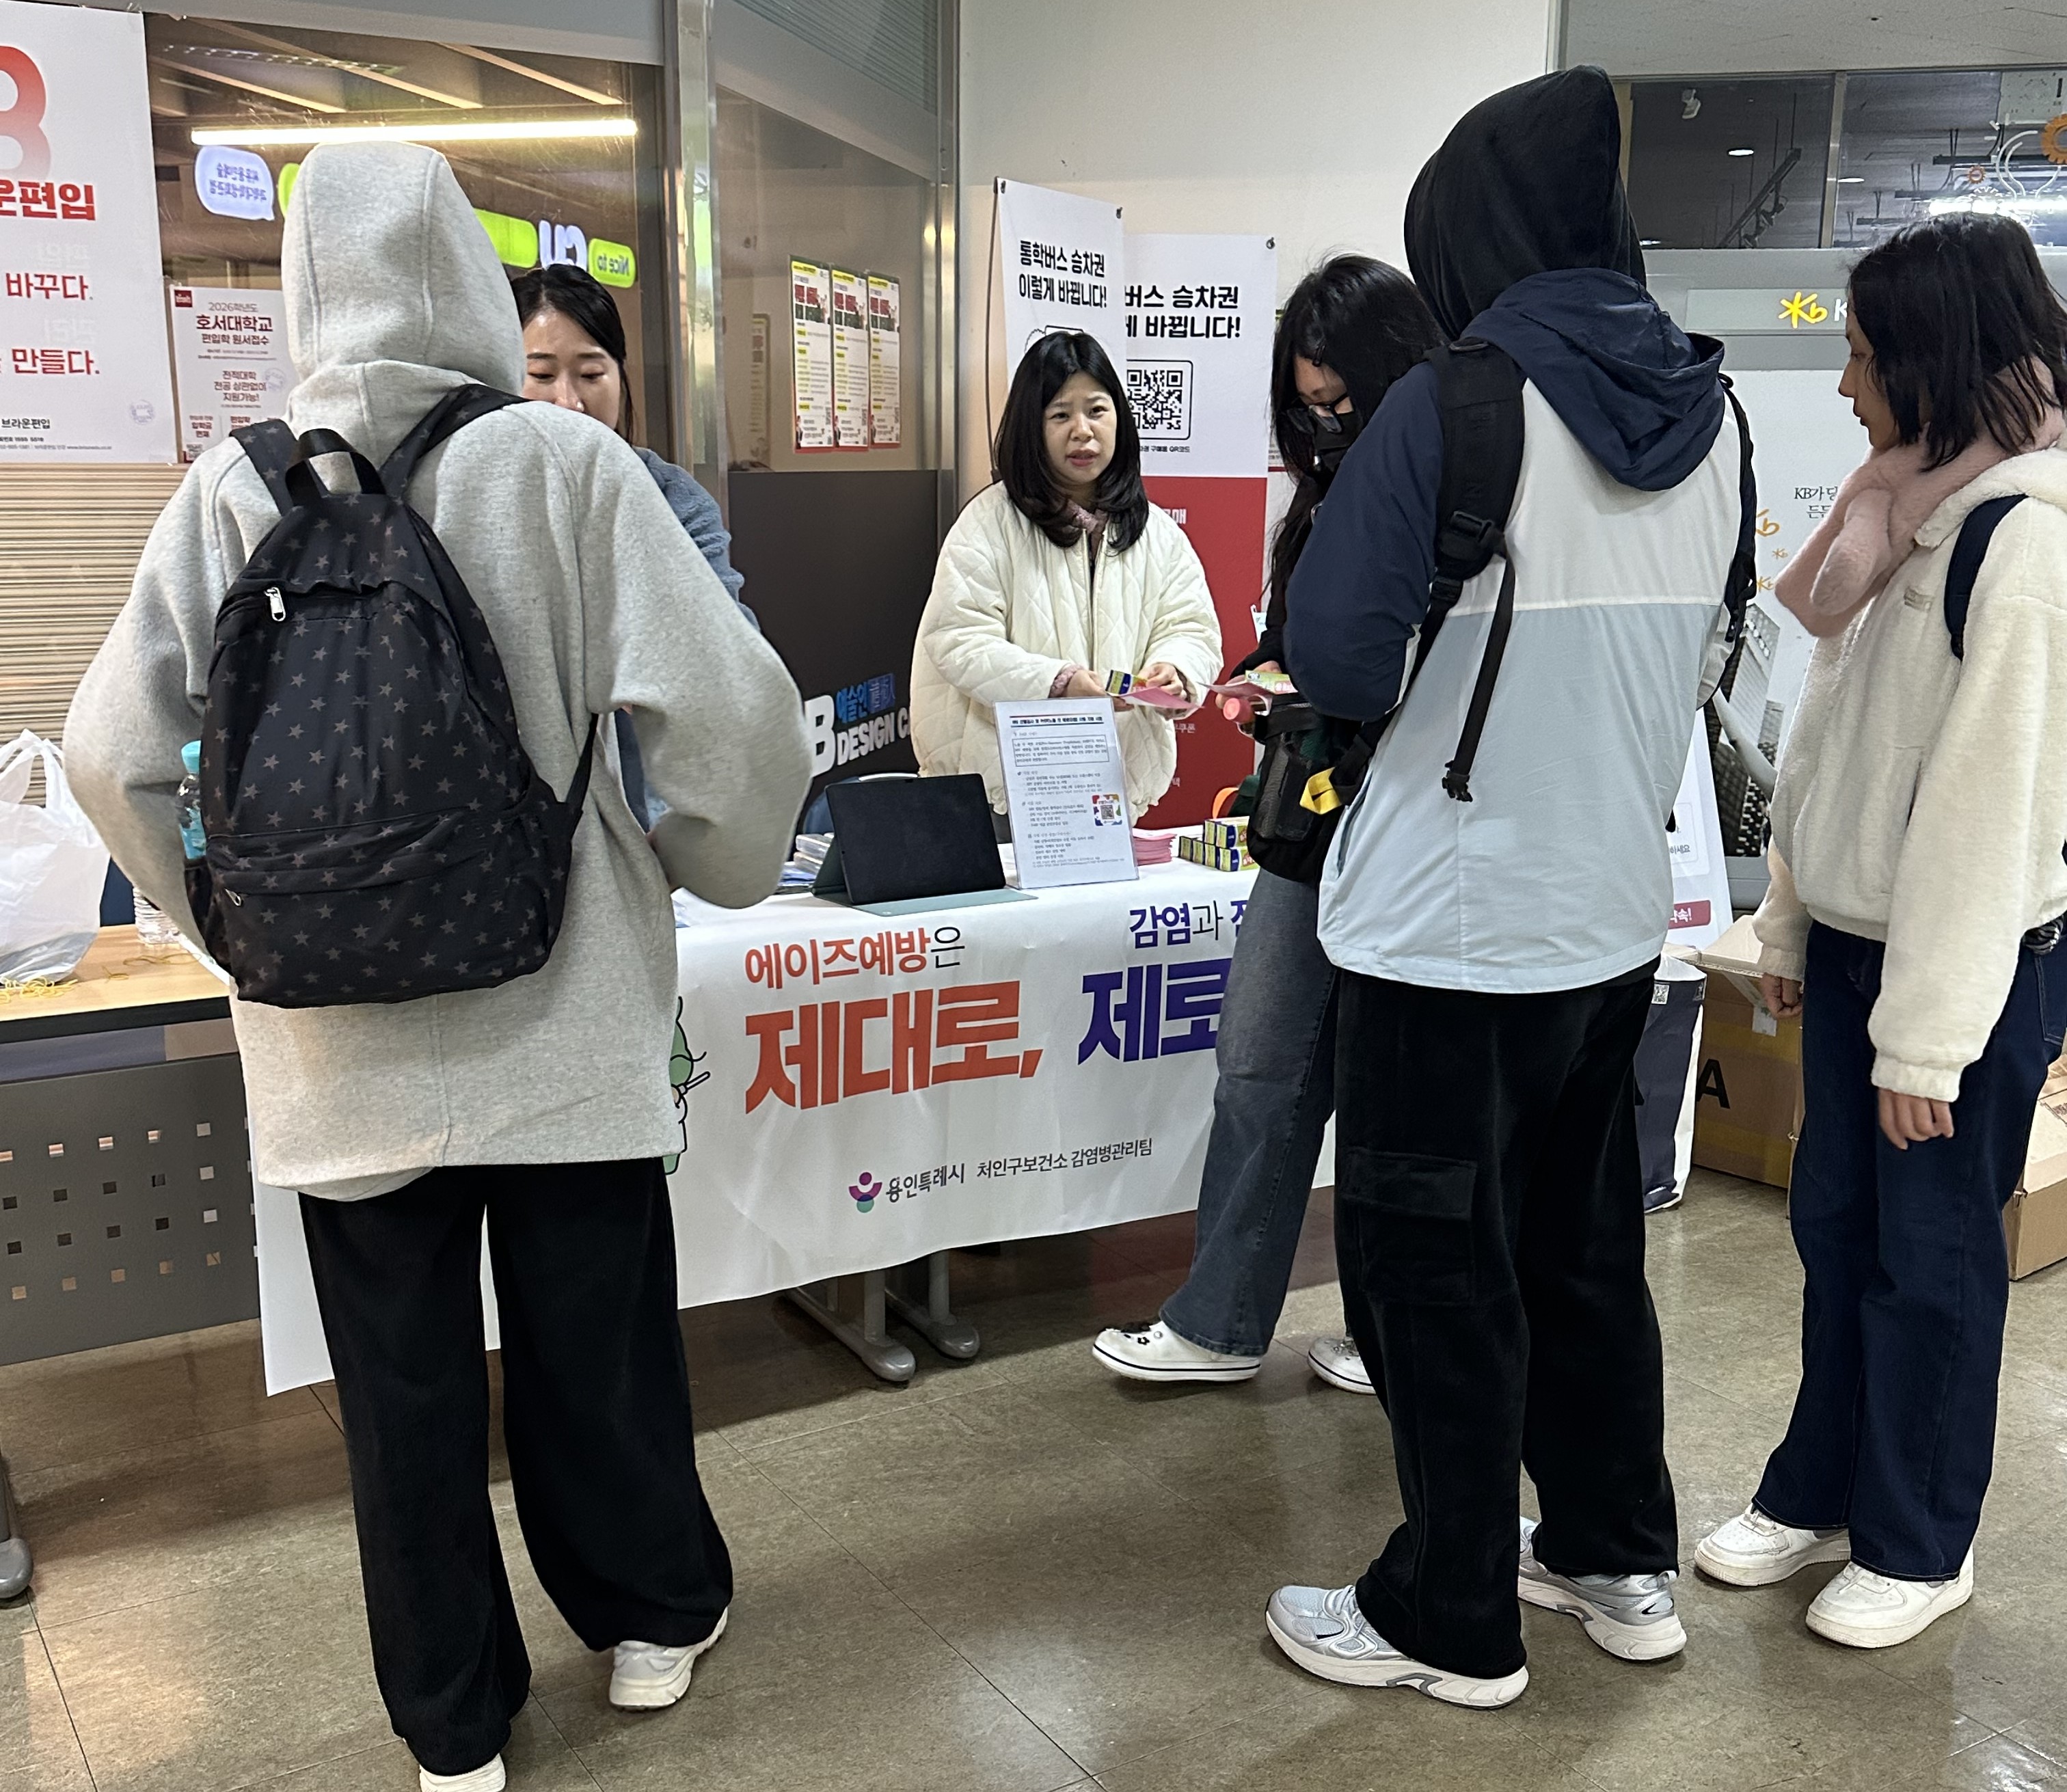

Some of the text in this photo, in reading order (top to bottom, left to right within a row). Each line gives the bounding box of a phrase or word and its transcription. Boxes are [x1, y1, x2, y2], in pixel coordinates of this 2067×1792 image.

[1020, 240, 1105, 277] 통학버스 승차권
[5, 273, 93, 301] 바꾸다.
[1018, 274, 1107, 308] 이렇게 바뀝니다!
[1172, 286, 1239, 309] 승차권
[196, 314, 273, 331] 호서대학교
[1145, 316, 1241, 338] 바뀝니다!
[202, 334, 269, 345] 편입학 원서접수
[12, 349, 100, 375] 만들다.
[1, 418, 51, 429] 브라운편입
[1794, 486, 1824, 500] KB가
[837, 707, 911, 765] DESIGN C
[1129, 900, 1224, 949] 감염과
[745, 926, 967, 989] 에이즈예방은
[745, 980, 1044, 1115] 제대로,
[886, 1137, 1154, 1203] 용인특례시 처인구보건소 감염병관리팀
